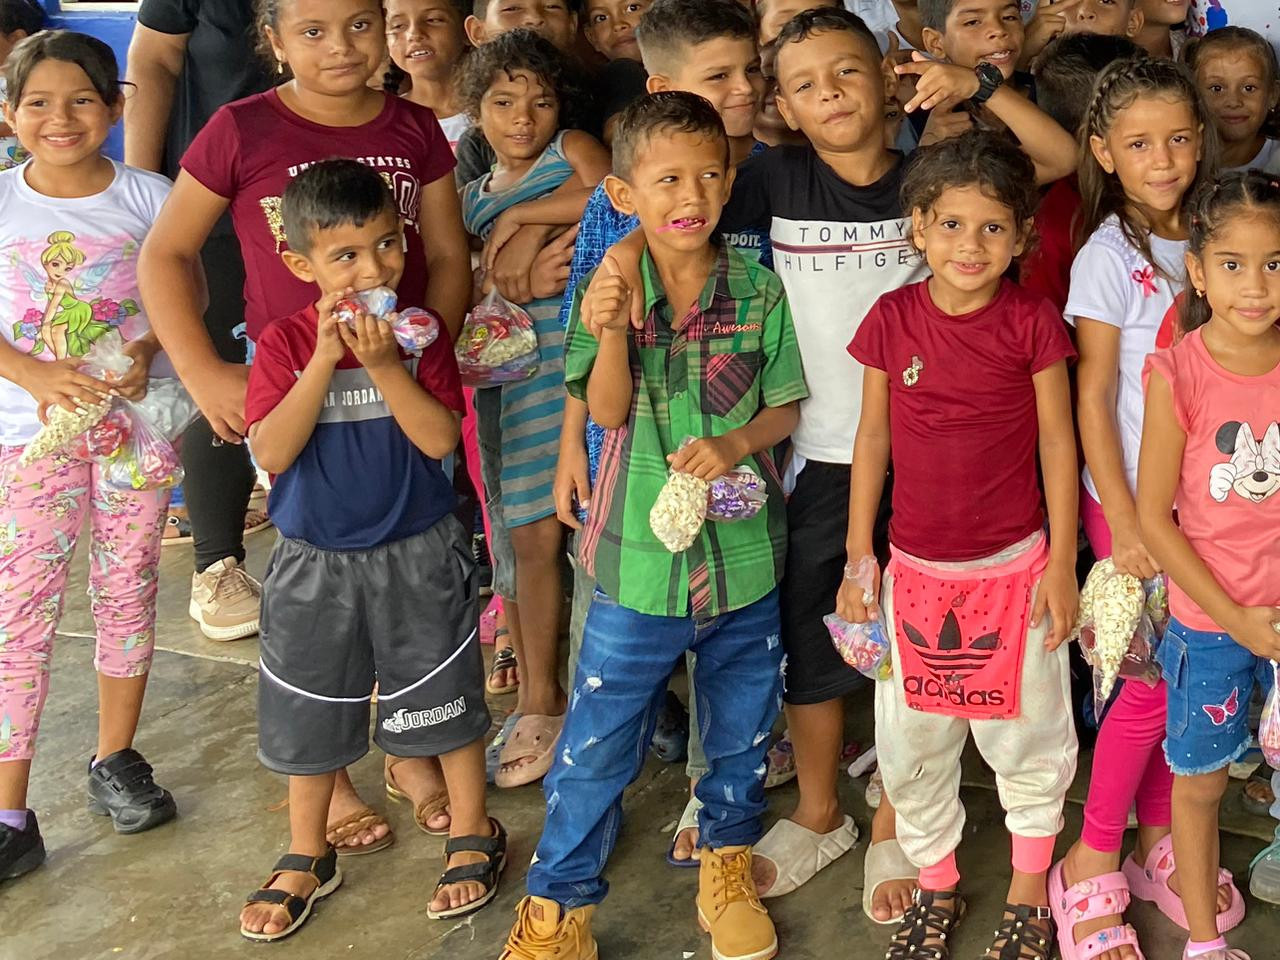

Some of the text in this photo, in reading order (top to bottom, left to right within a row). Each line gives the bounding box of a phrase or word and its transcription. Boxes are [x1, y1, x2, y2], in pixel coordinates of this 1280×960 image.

[799, 221, 907, 243] TOMMY
[784, 249, 910, 272] HILFIGE
[342, 387, 384, 406] JORDAN
[401, 696, 467, 730] JORDAN
